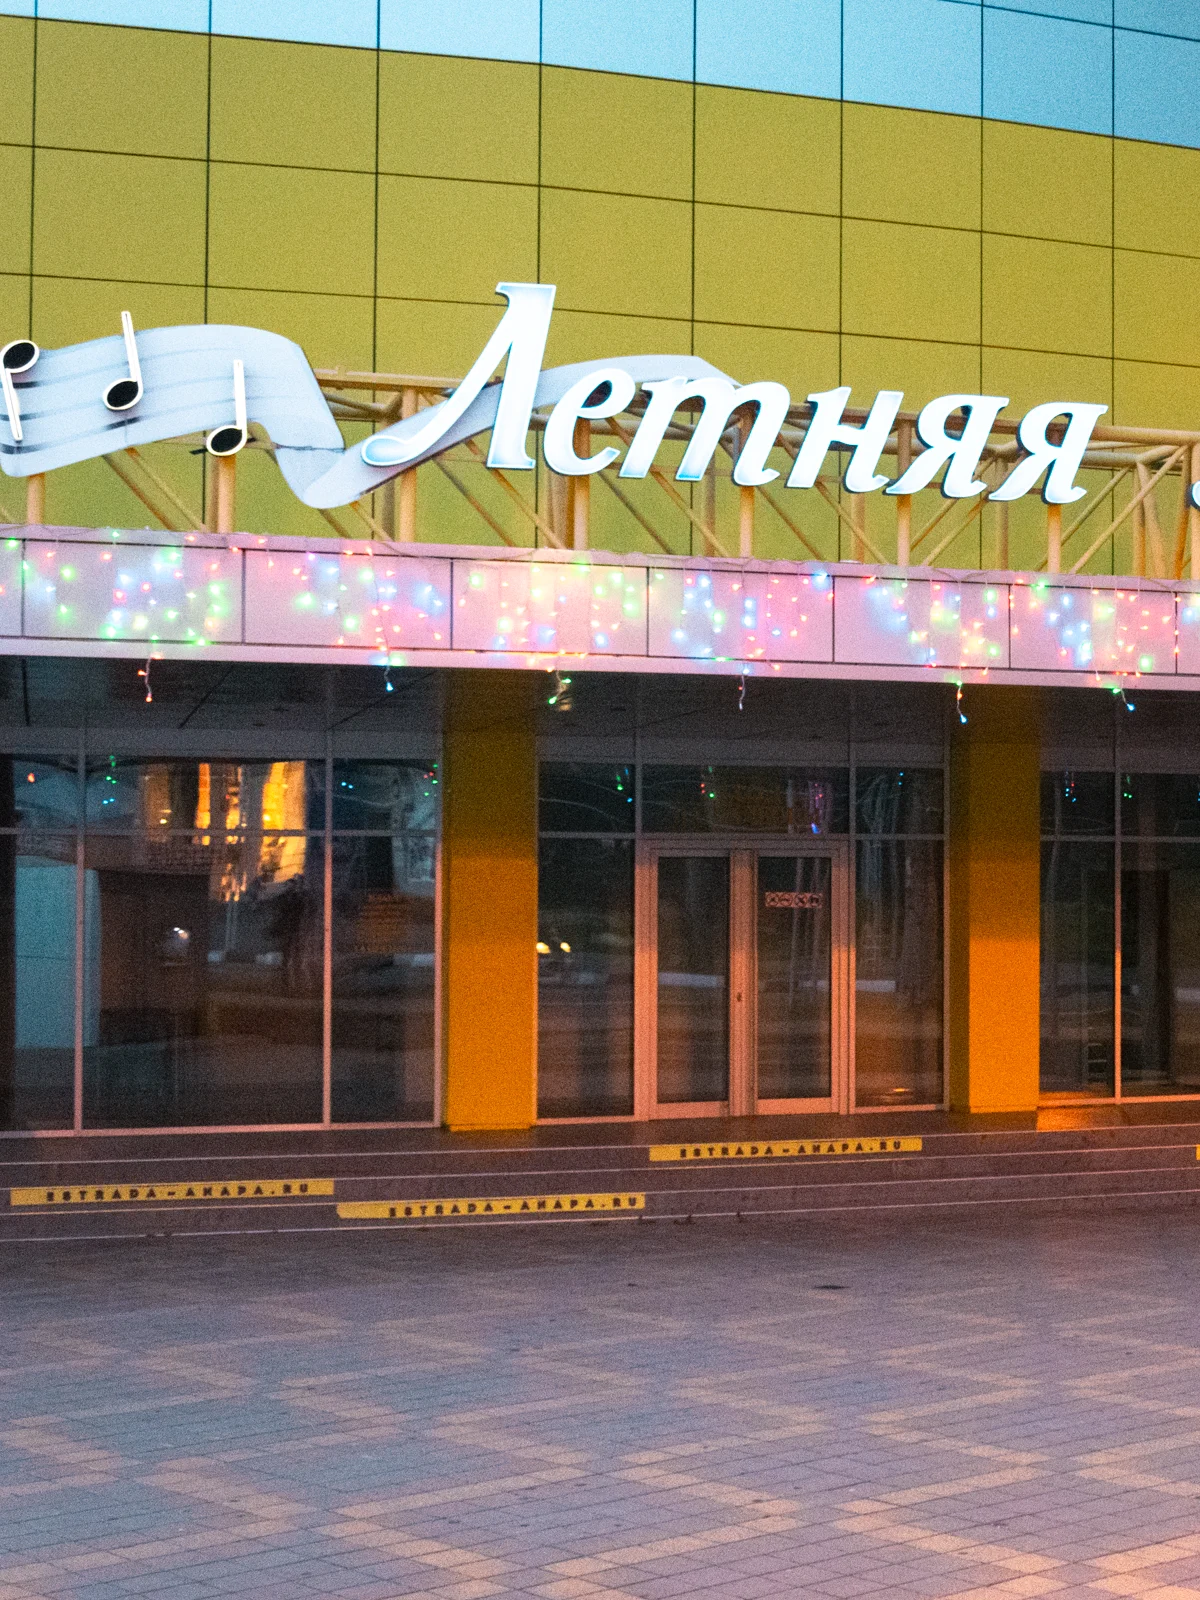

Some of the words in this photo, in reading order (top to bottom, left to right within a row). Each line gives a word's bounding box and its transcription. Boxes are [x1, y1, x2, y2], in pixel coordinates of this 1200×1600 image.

[361, 281, 1109, 505] Летняя
[680, 1140, 901, 1158] ESTRADA-ANAPA.RU
[46, 1182, 309, 1203] ESTRADA-ANAPA.RU
[389, 1196, 638, 1218] ESTRADA-ANAPA.RU
